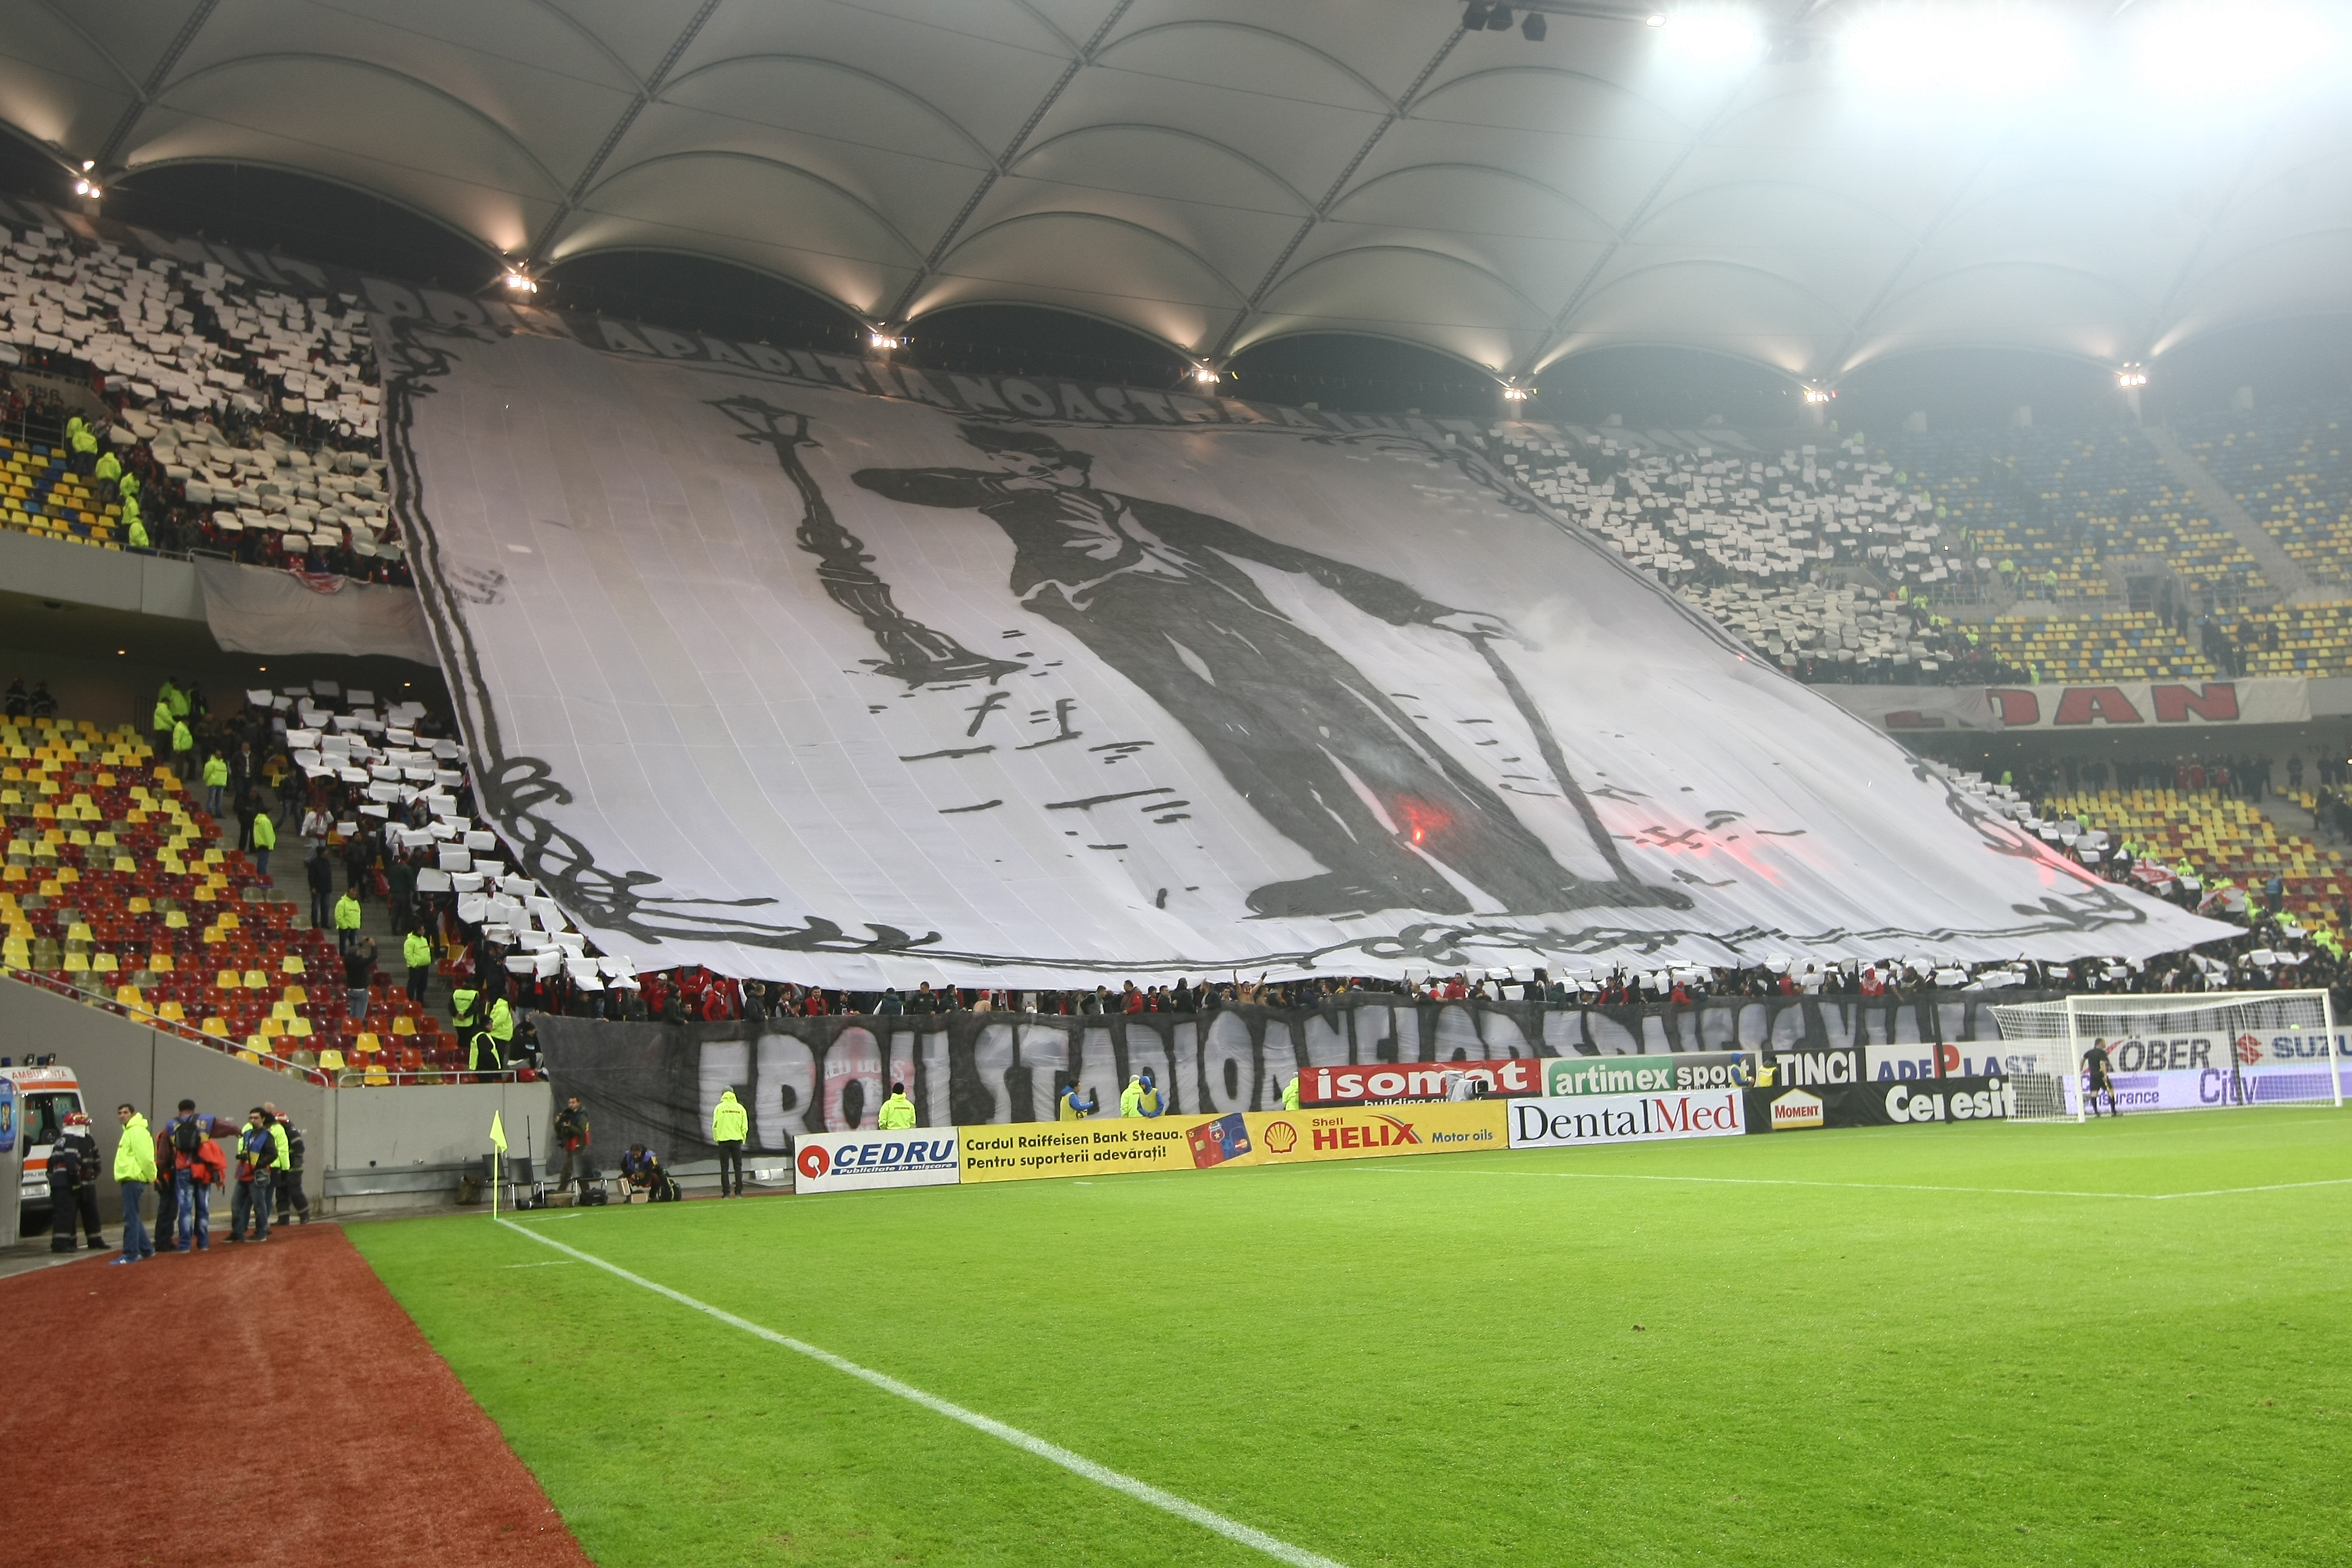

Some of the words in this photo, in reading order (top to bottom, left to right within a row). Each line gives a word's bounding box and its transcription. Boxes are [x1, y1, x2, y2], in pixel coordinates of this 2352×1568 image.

[2099, 1030, 2211, 1074] ÖBER
[1317, 1060, 1528, 1100] isomat
[1555, 1064, 1670, 1095] artimex
[1312, 1117, 1344, 1127] Shell
[1514, 1094, 1739, 1141] DentalMed
[1774, 1105, 1820, 1119] MOMENT
[967, 1137, 1014, 1151] Cardul
[1019, 1133, 1089, 1148] Raiffeisen
[1093, 1131, 1128, 1144] Bank
[1132, 1128, 1183, 1141] Steaua.
[1312, 1123, 1420, 1151] HELIX
[1432, 1132, 1470, 1143] Motor
[1473, 1129, 1494, 1142] oils
[834, 1140, 955, 1168] CEDRU
[967, 1156, 1016, 1169] Pentru
[1020, 1152, 1089, 1168] suporterii
[839, 1165, 895, 1175] Publicitate
